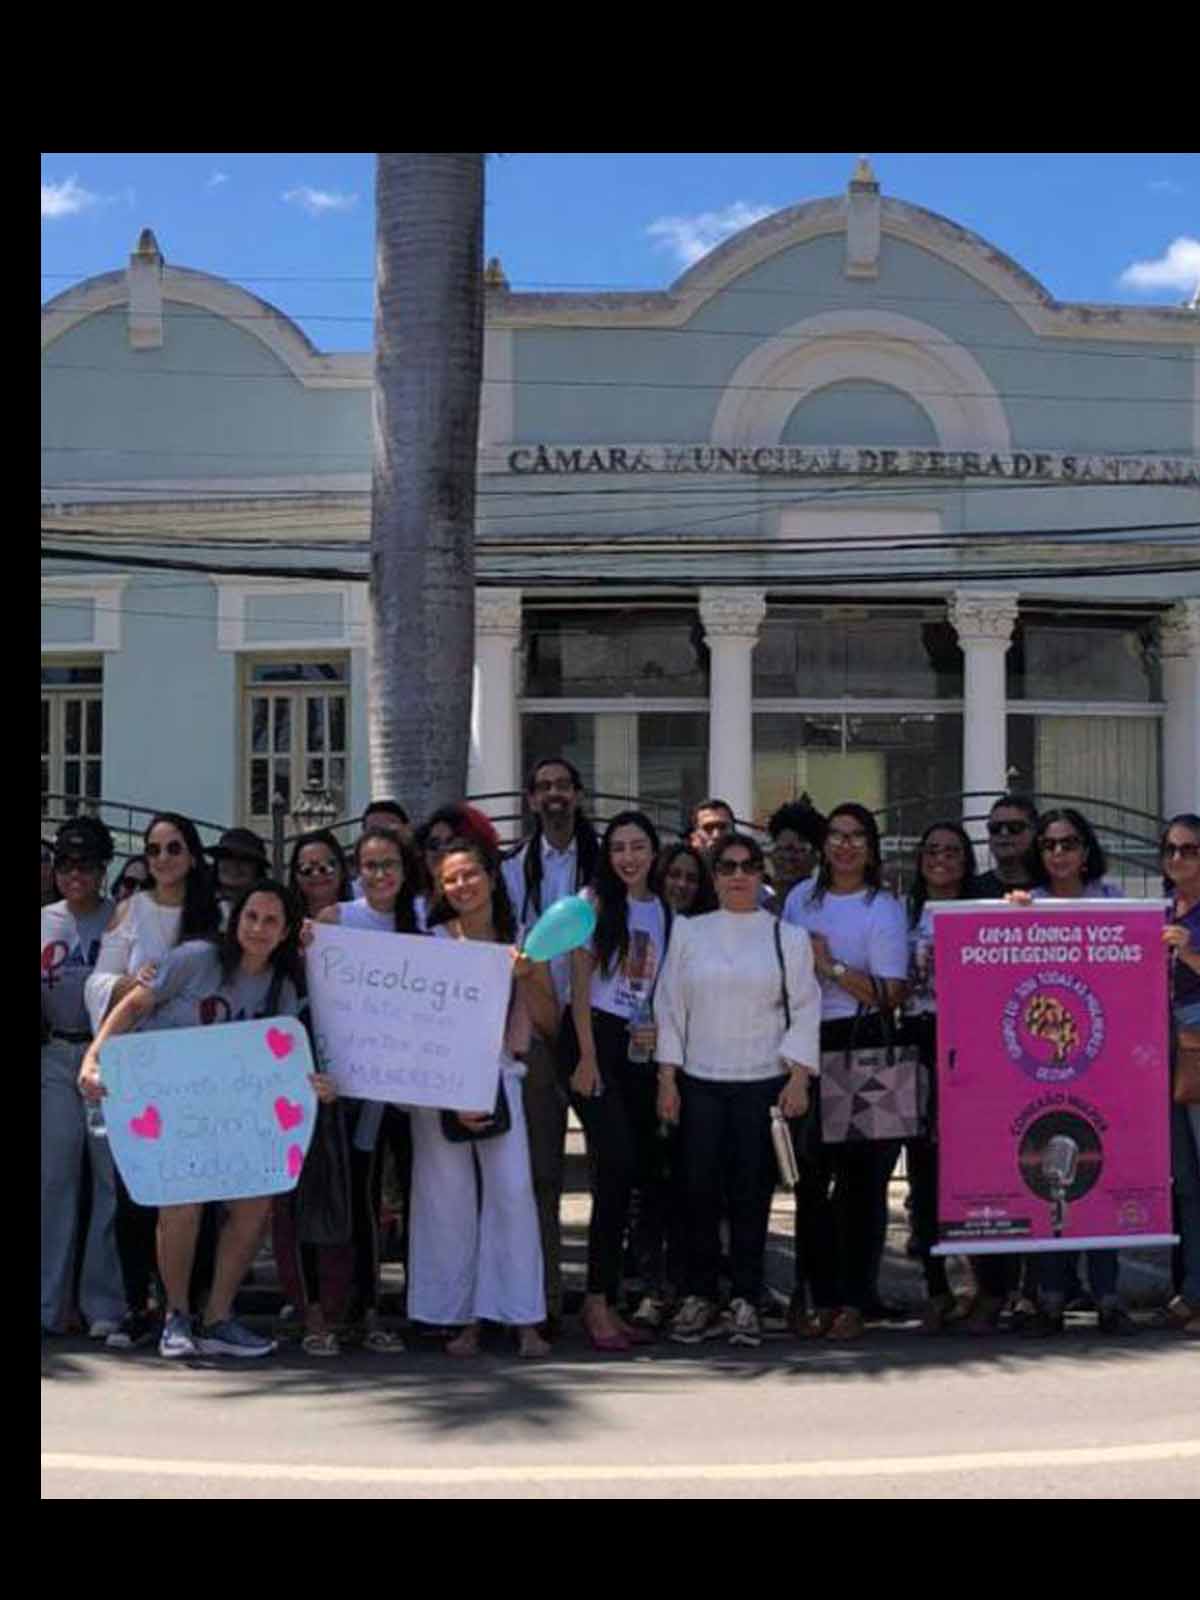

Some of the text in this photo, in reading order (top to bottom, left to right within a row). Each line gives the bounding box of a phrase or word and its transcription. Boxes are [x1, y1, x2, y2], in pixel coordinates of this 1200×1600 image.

[508, 444, 651, 473] CÂMARA
[860, 449, 898, 473] DE
[1009, 453, 1049, 478] DE
[979, 923, 1126, 944] UMA ÚNICA VOZ
[961, 944, 1144, 965] PROTEGENDO TODAS
[321, 945, 481, 1012] Psicologia
